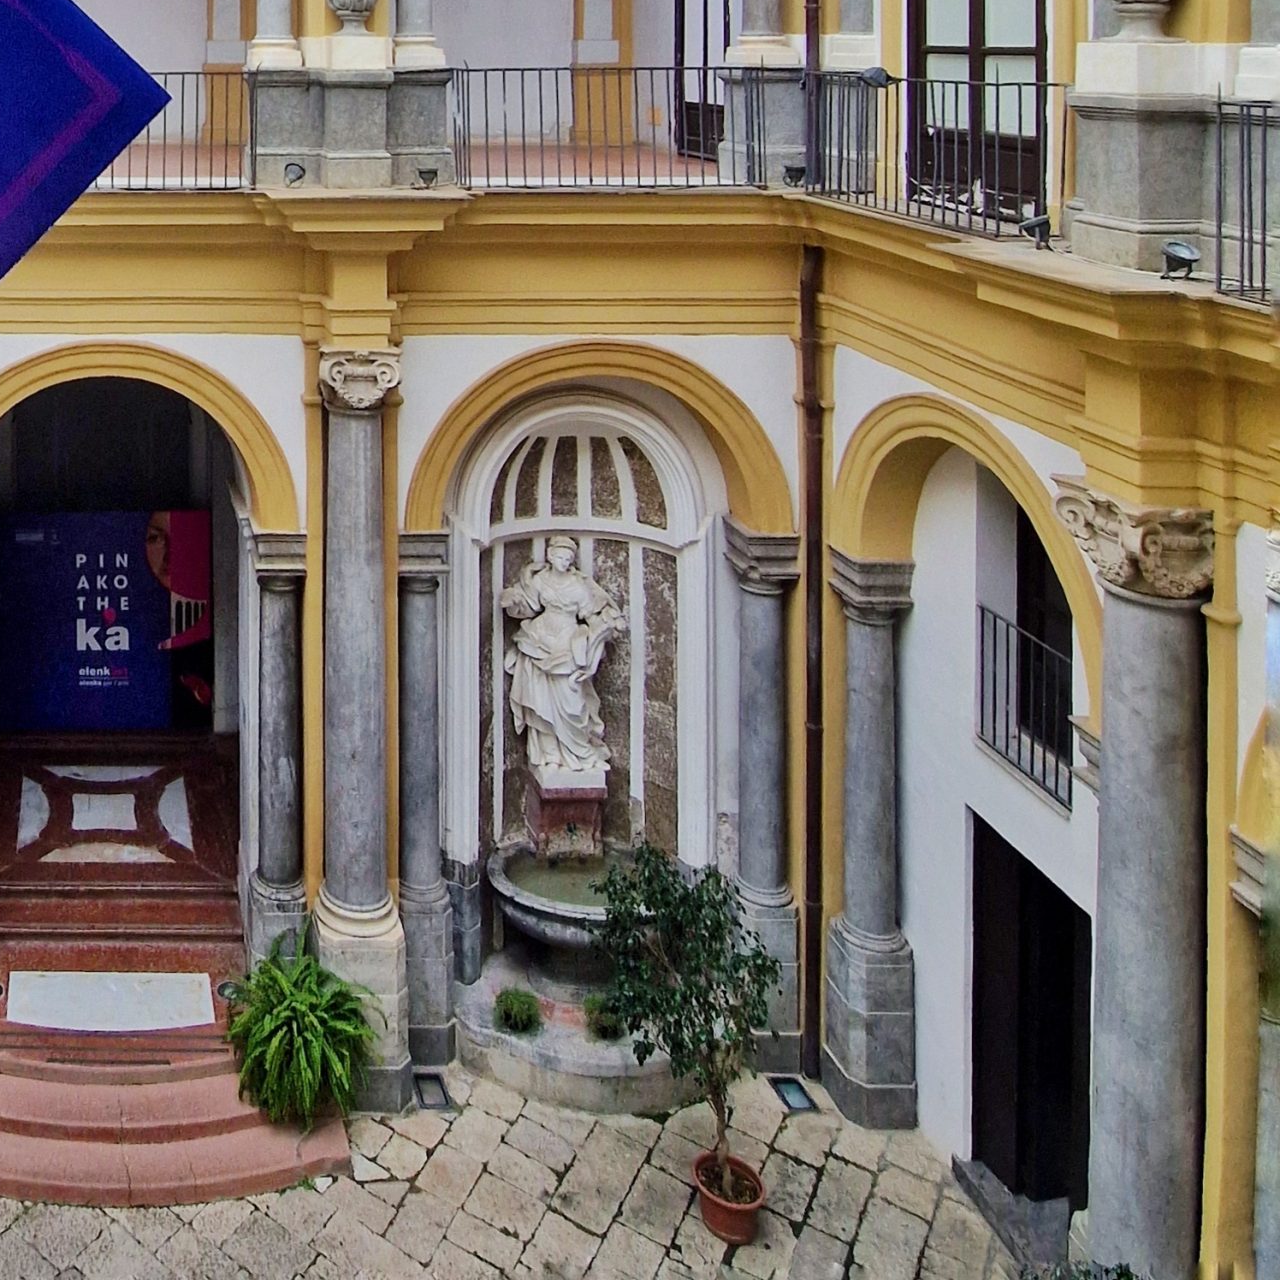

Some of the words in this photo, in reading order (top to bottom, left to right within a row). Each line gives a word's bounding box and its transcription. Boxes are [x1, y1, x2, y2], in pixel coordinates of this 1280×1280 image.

[75, 553, 128, 568] PIN
[76, 575, 129, 589] AKO
[76, 596, 129, 611] THE
[76, 618, 130, 651] ka
